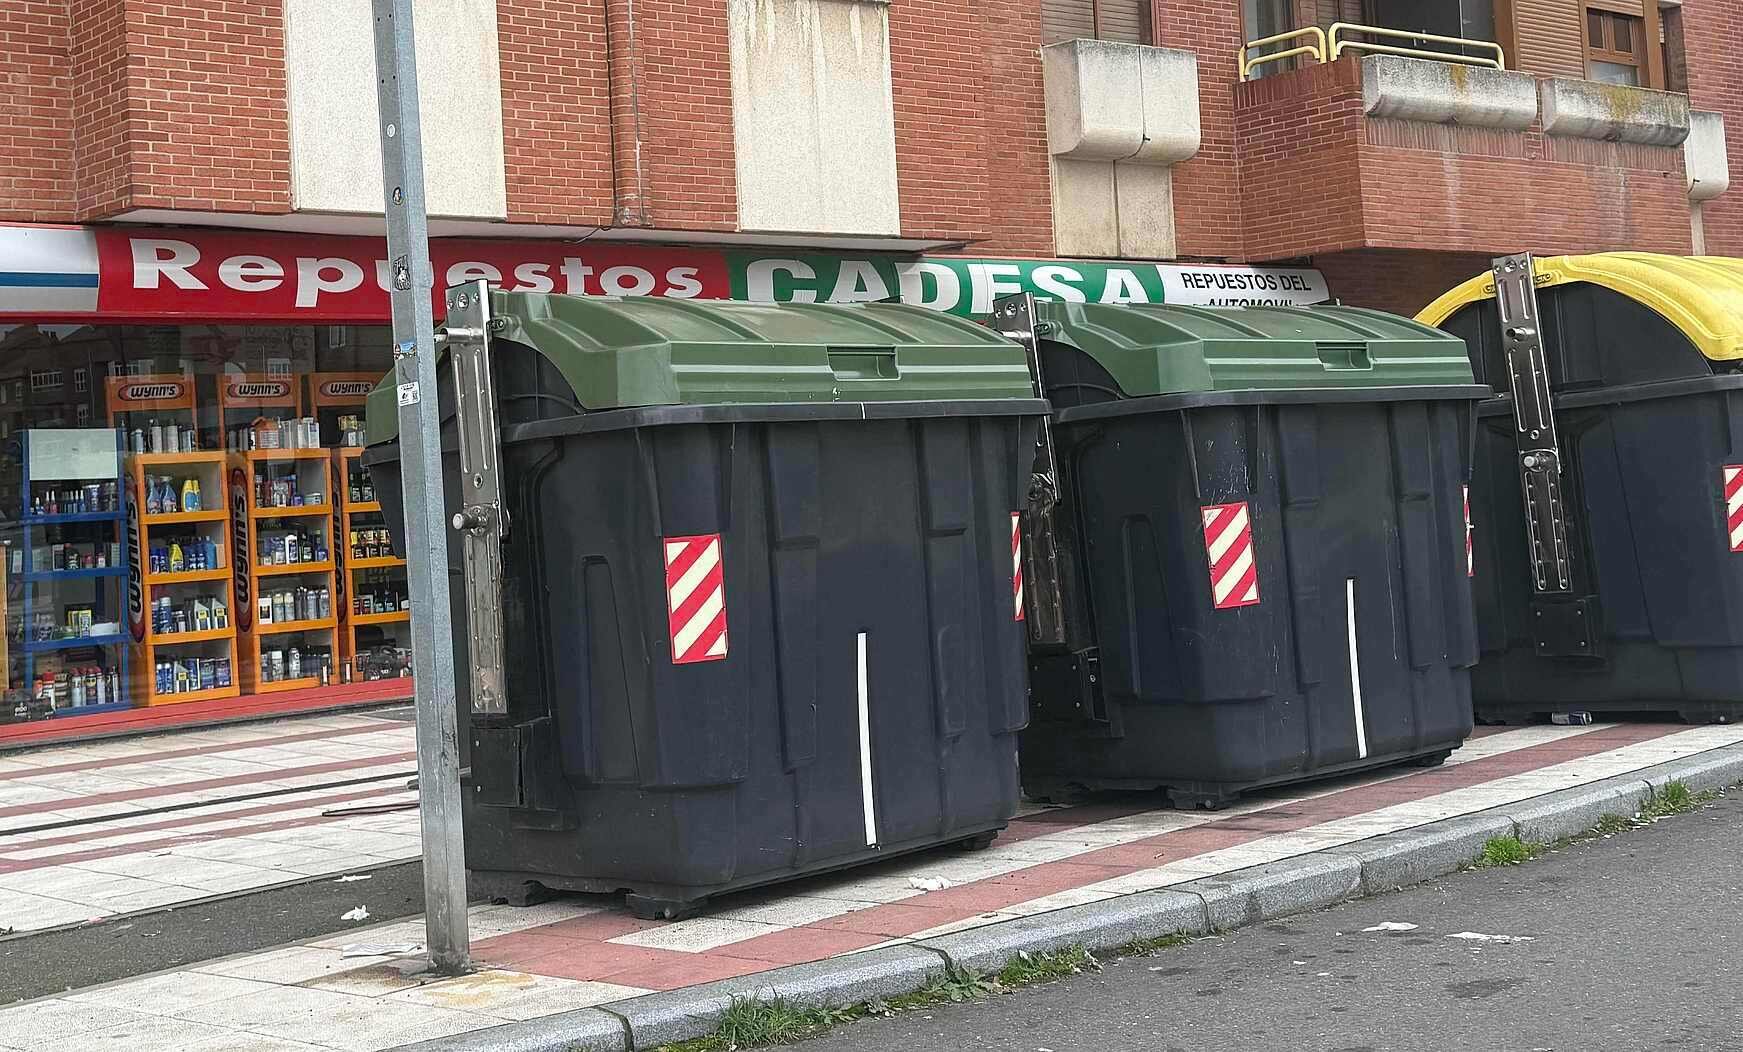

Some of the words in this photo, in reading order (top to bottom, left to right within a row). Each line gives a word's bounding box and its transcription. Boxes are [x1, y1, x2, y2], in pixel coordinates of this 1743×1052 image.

[746, 258, 1148, 314] CADESA
[1181, 273, 1277, 290] REPUESTOS
[1279, 275, 1312, 291] DEL
